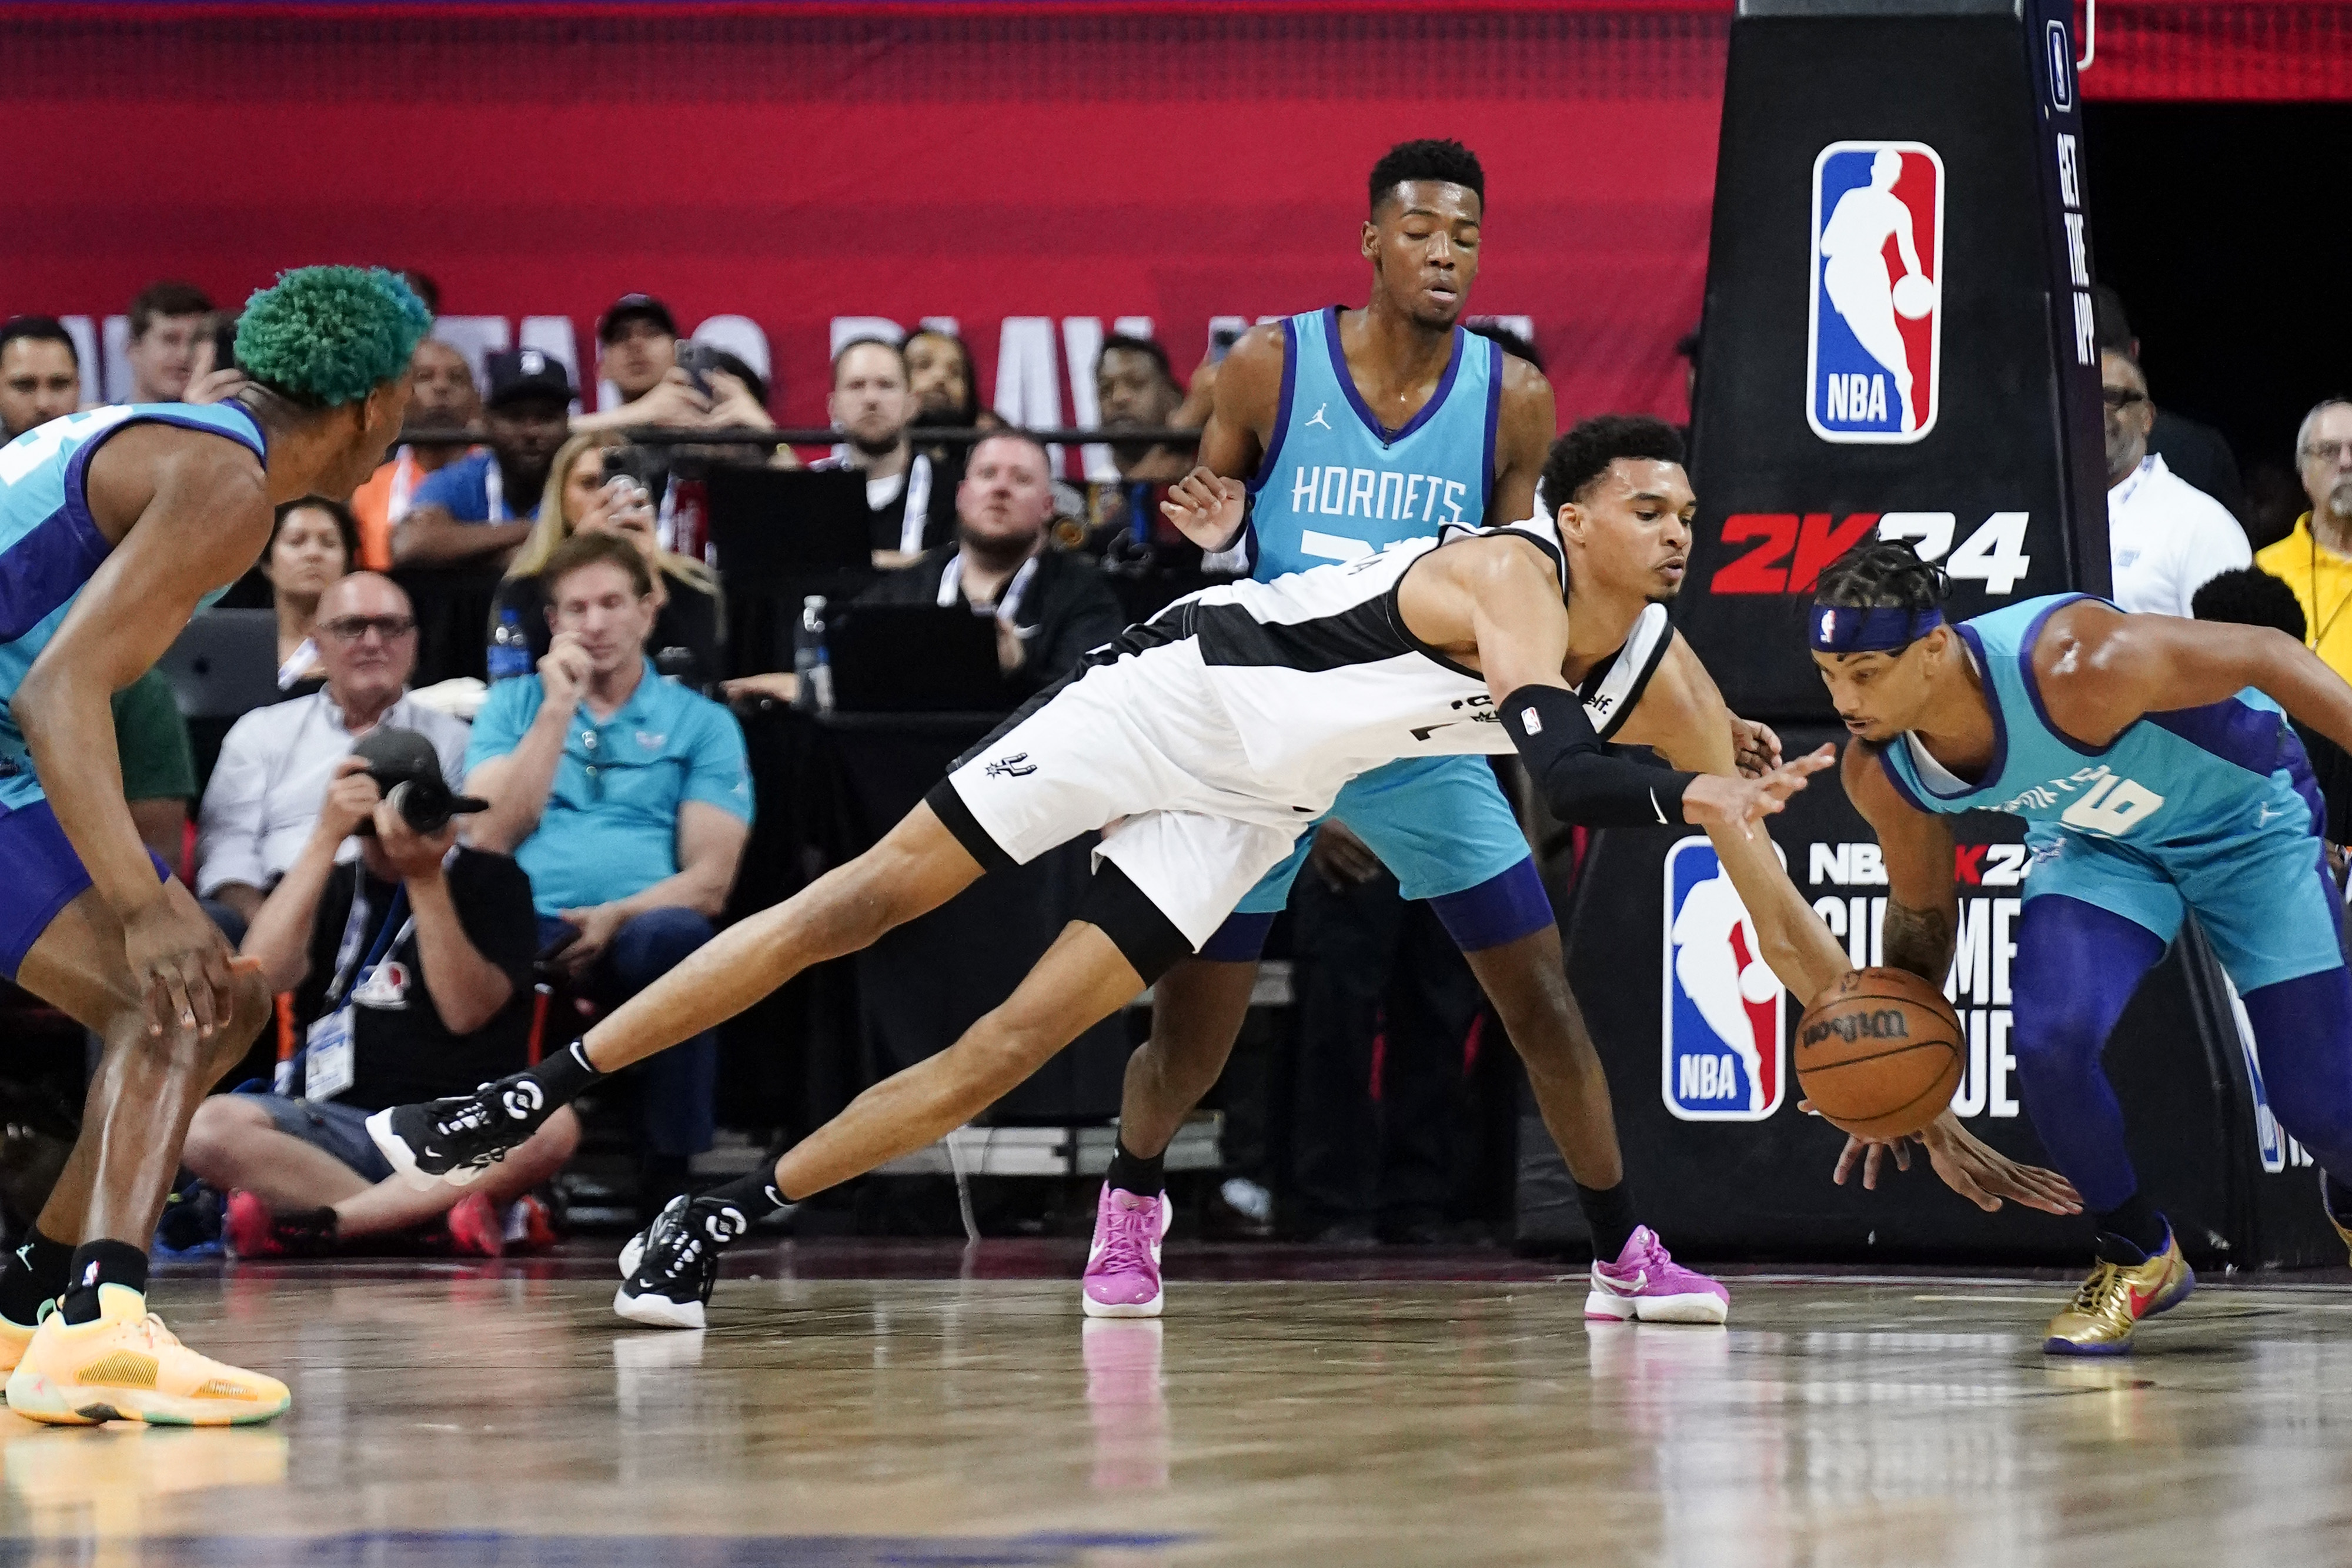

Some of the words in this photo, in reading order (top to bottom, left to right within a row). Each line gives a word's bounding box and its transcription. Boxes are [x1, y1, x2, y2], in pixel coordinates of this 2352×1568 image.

[2057, 132, 2080, 208] GET
[2064, 212, 2090, 287] THE
[2073, 292, 2095, 366] APP
[1827, 373, 1887, 422] NBA
[1290, 466, 1466, 525] HORNETS
[1586, 694, 1613, 715] elf.
[1809, 842, 1889, 885] NB
[1955, 844, 2034, 887] K2
[1679, 1054, 1738, 1099] NBA
